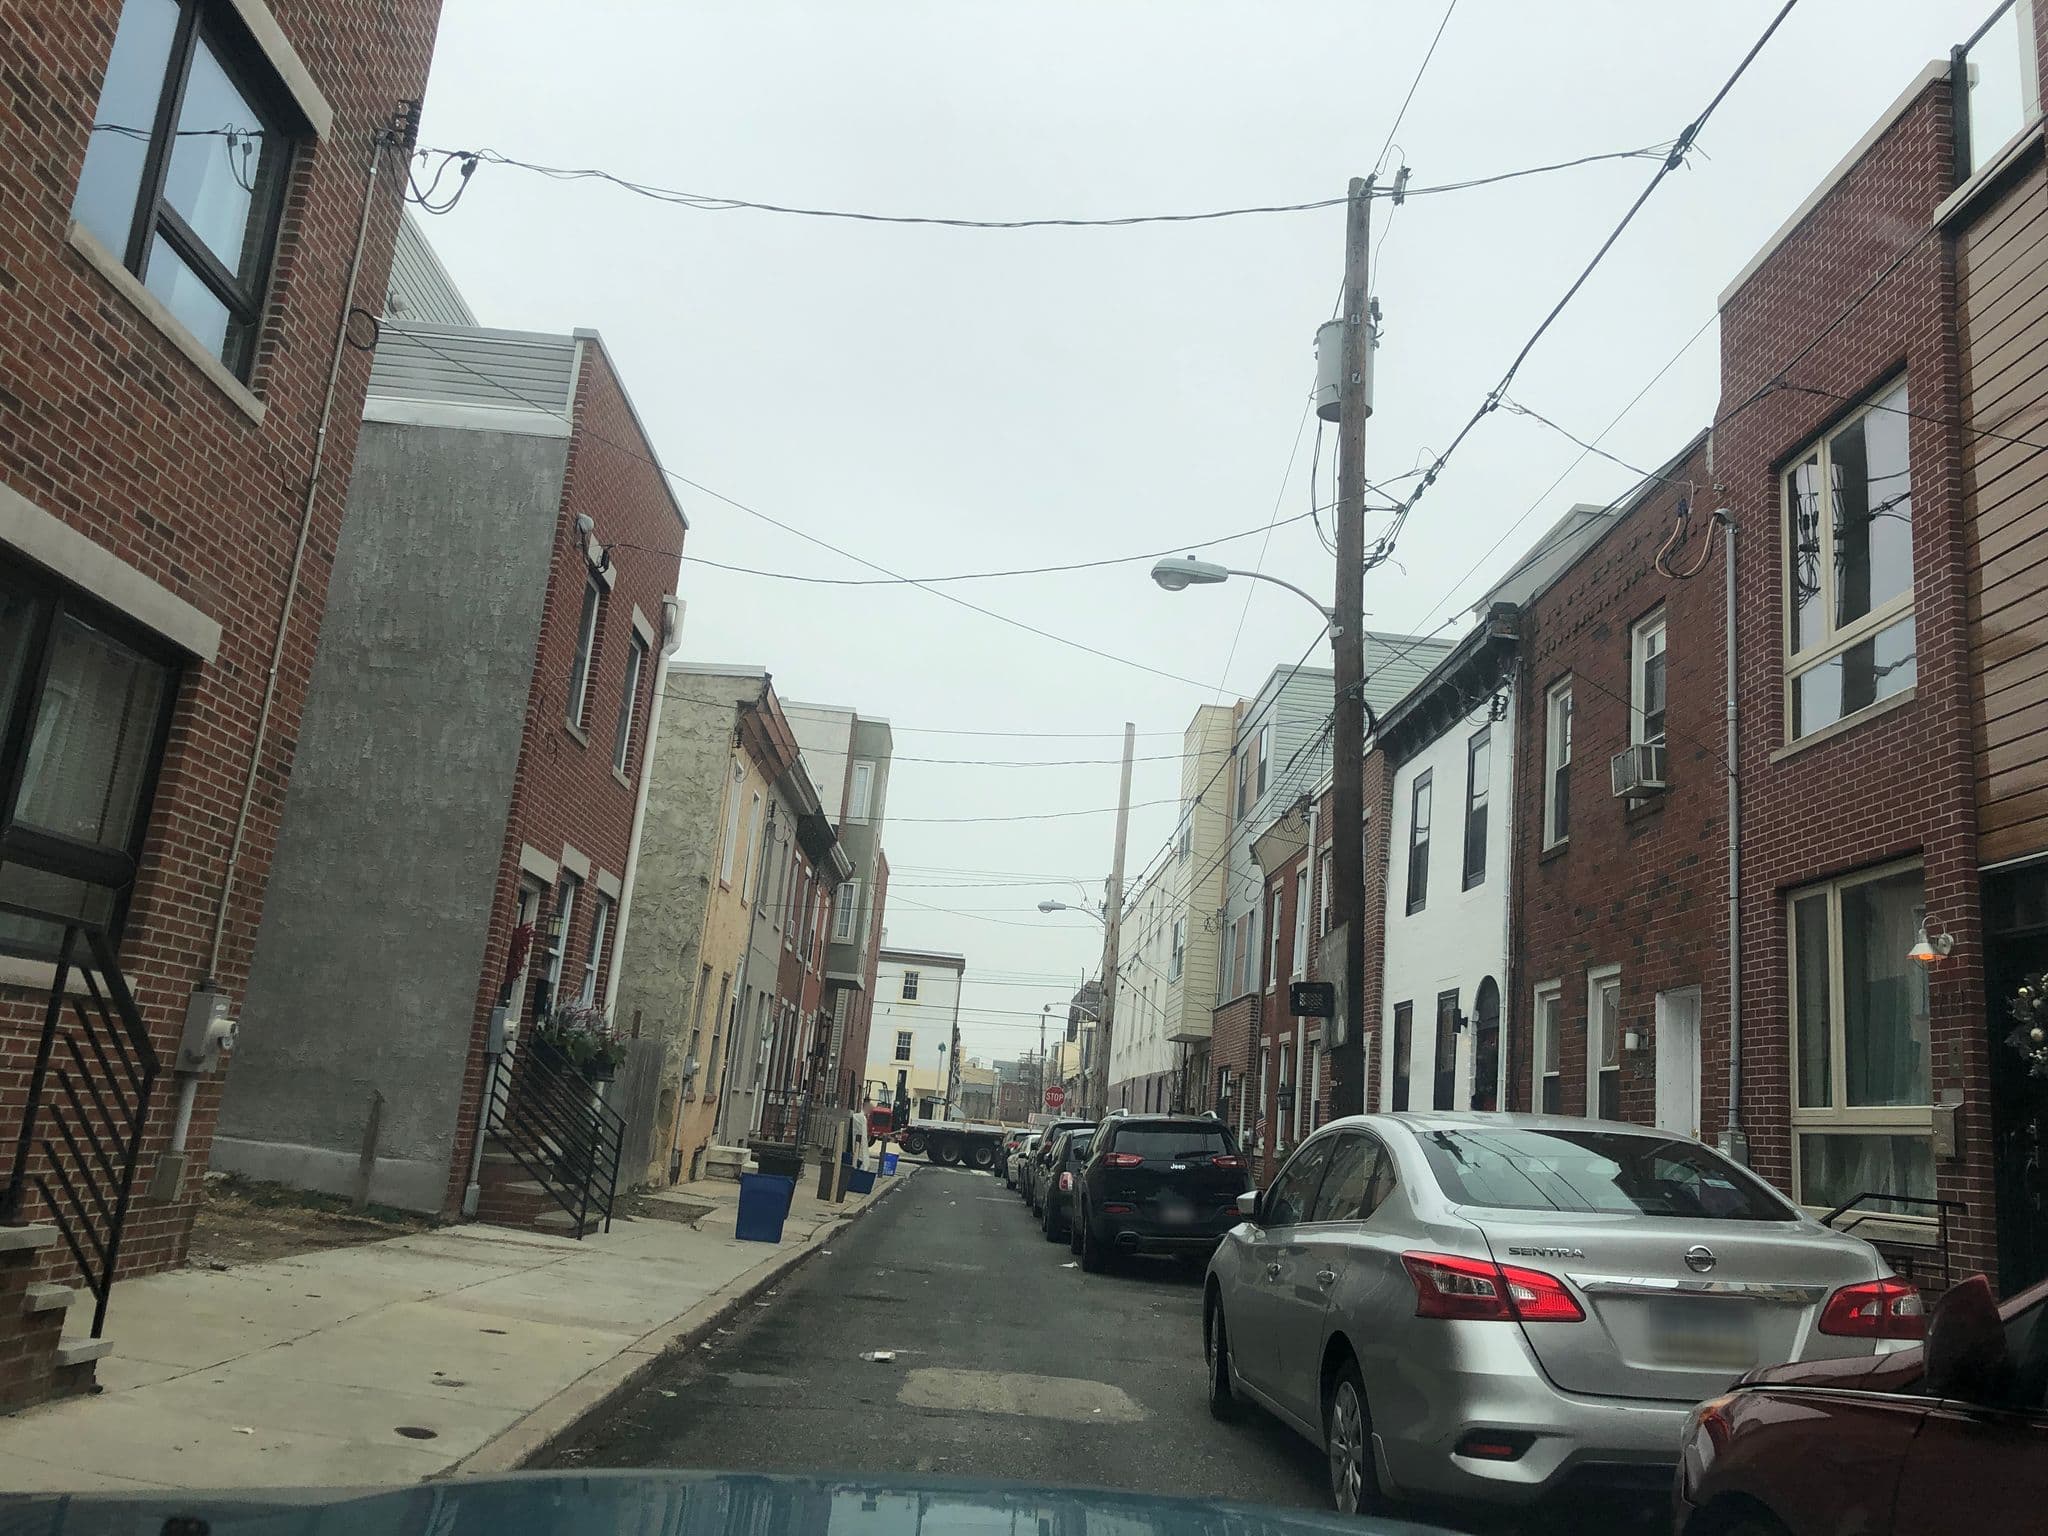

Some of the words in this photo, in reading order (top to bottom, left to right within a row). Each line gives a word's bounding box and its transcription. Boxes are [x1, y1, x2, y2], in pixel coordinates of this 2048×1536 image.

[1046, 1092, 1064, 1101] STOP
[1170, 1162, 1186, 1170] Jeep
[1508, 1246, 1586, 1259] SENTRA
